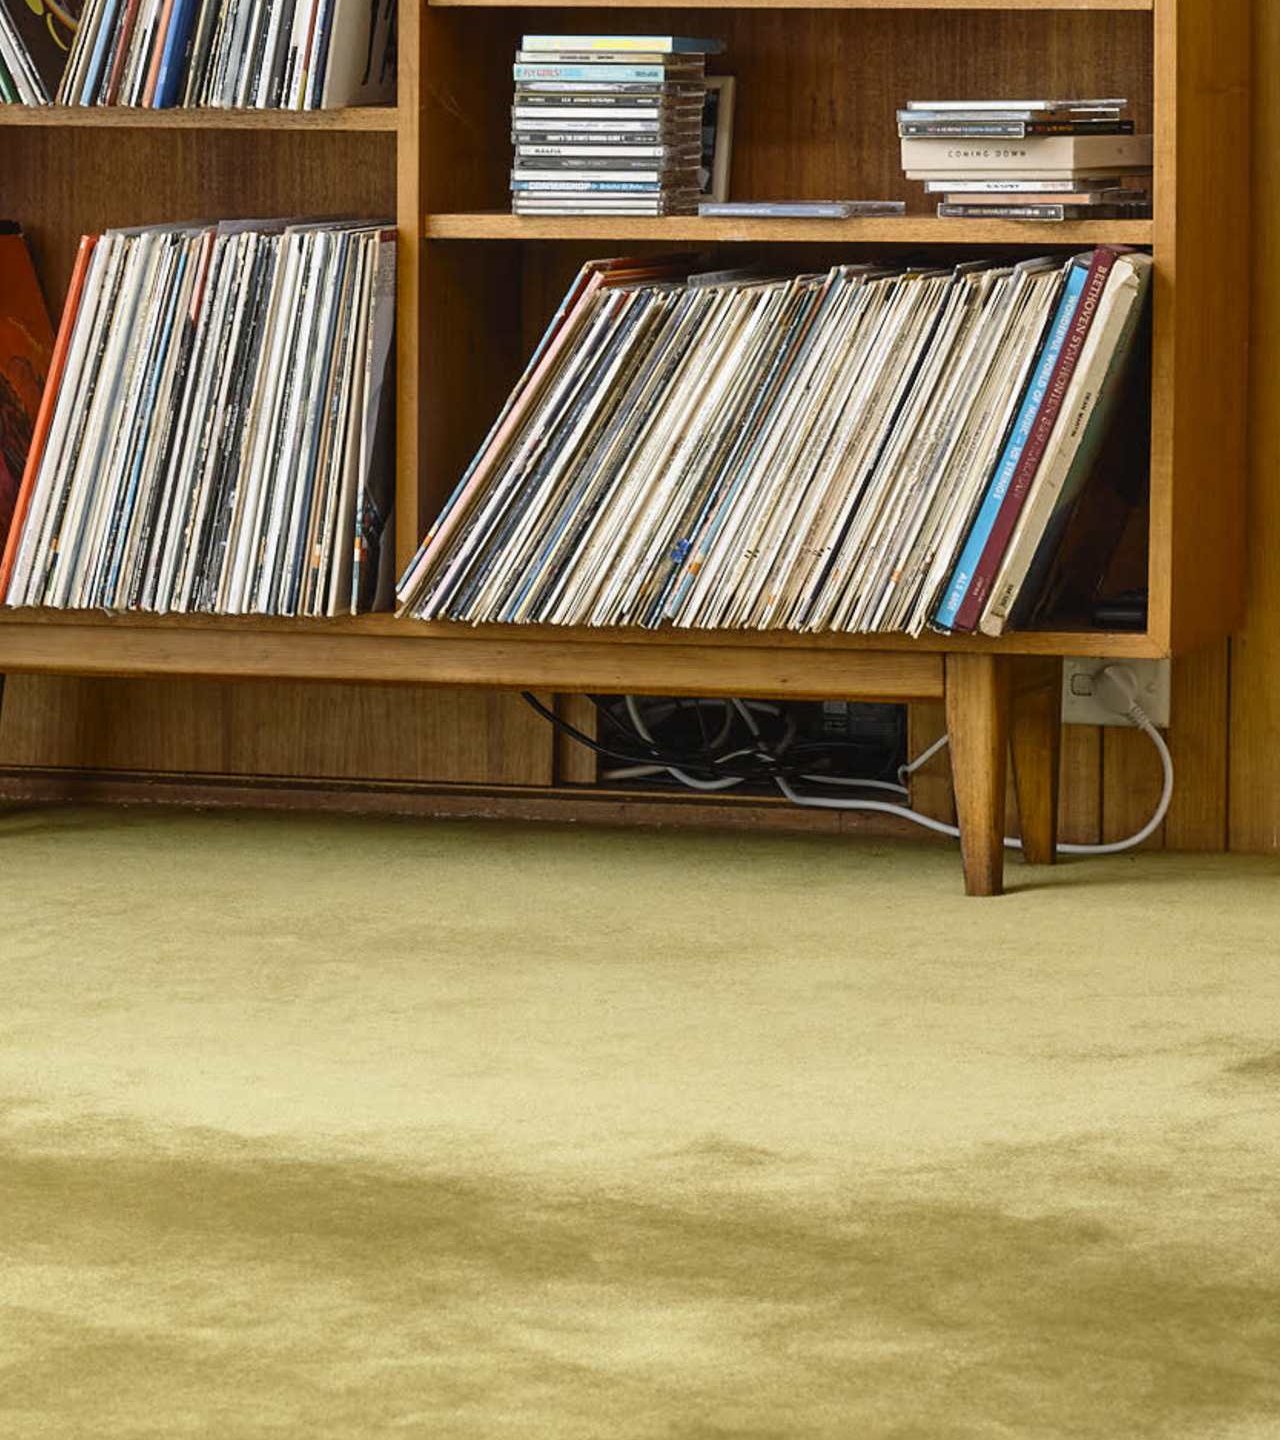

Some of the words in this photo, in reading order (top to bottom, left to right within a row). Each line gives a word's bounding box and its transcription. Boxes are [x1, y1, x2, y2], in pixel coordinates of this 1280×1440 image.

[948, 150, 990, 158] COMING
[995, 150, 1026, 158] DOWN
[1074, 265, 1107, 334] BEETHOVEN
[1048, 294, 1077, 352] WONDERFUL
[1036, 353, 1054, 388] WORLD
[1031, 388, 1041, 403] OF
[1018, 403, 1036, 435] MUSIC
[992, 458, 1014, 500] STRINGS
